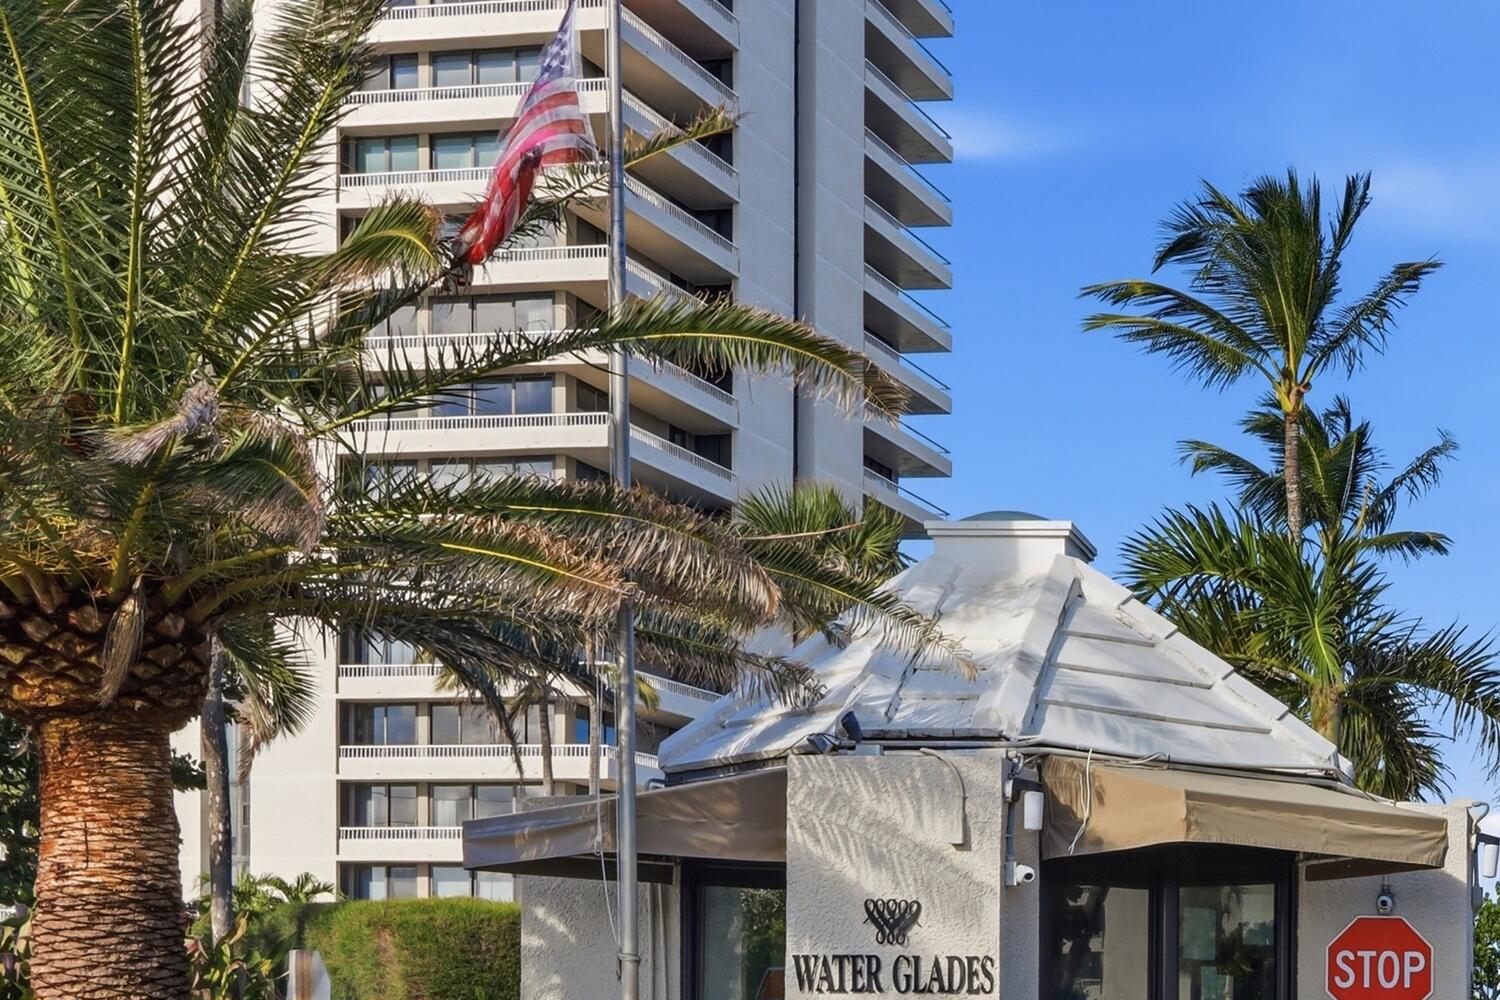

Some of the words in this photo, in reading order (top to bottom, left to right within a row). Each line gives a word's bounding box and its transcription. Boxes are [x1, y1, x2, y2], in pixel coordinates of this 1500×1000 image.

[792, 954, 883, 994] WATER
[892, 954, 995, 995] GLADES
[1334, 949, 1426, 989] STOP
